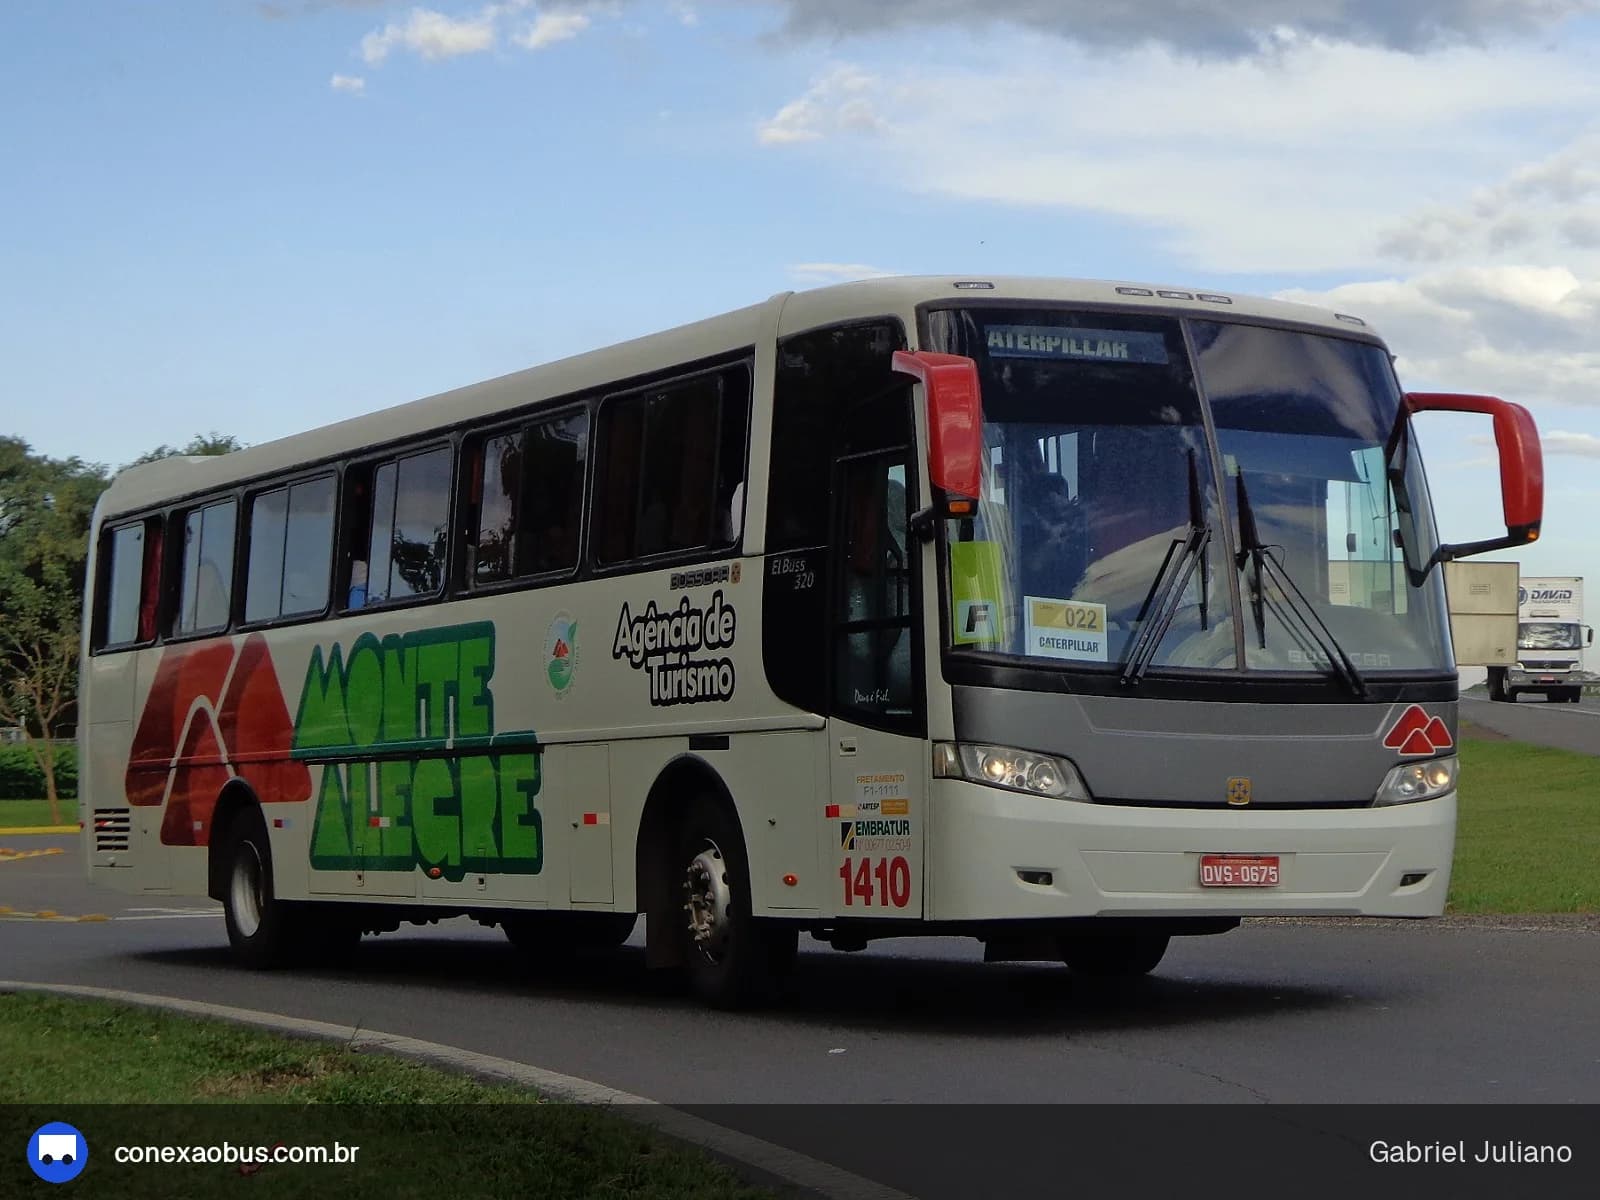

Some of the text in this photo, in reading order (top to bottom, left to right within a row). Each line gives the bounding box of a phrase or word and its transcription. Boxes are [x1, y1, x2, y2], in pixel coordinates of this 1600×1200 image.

[795, 572, 815, 589] 320
[612, 595, 703, 669] Agência
[703, 589, 736, 651] de
[1065, 607, 1097, 629] 022
[1039, 636, 1099, 653] CATERPILLAR
[291, 620, 496, 758] MONTE
[647, 652, 735, 706] Turismo
[856, 774, 905, 784] FRETAMENTO
[310, 732, 543, 881] ALEGRE
[855, 820, 910, 836] EMBRATUR
[839, 856, 911, 908] 1410
[1203, 865, 1278, 883] DVS-0675
